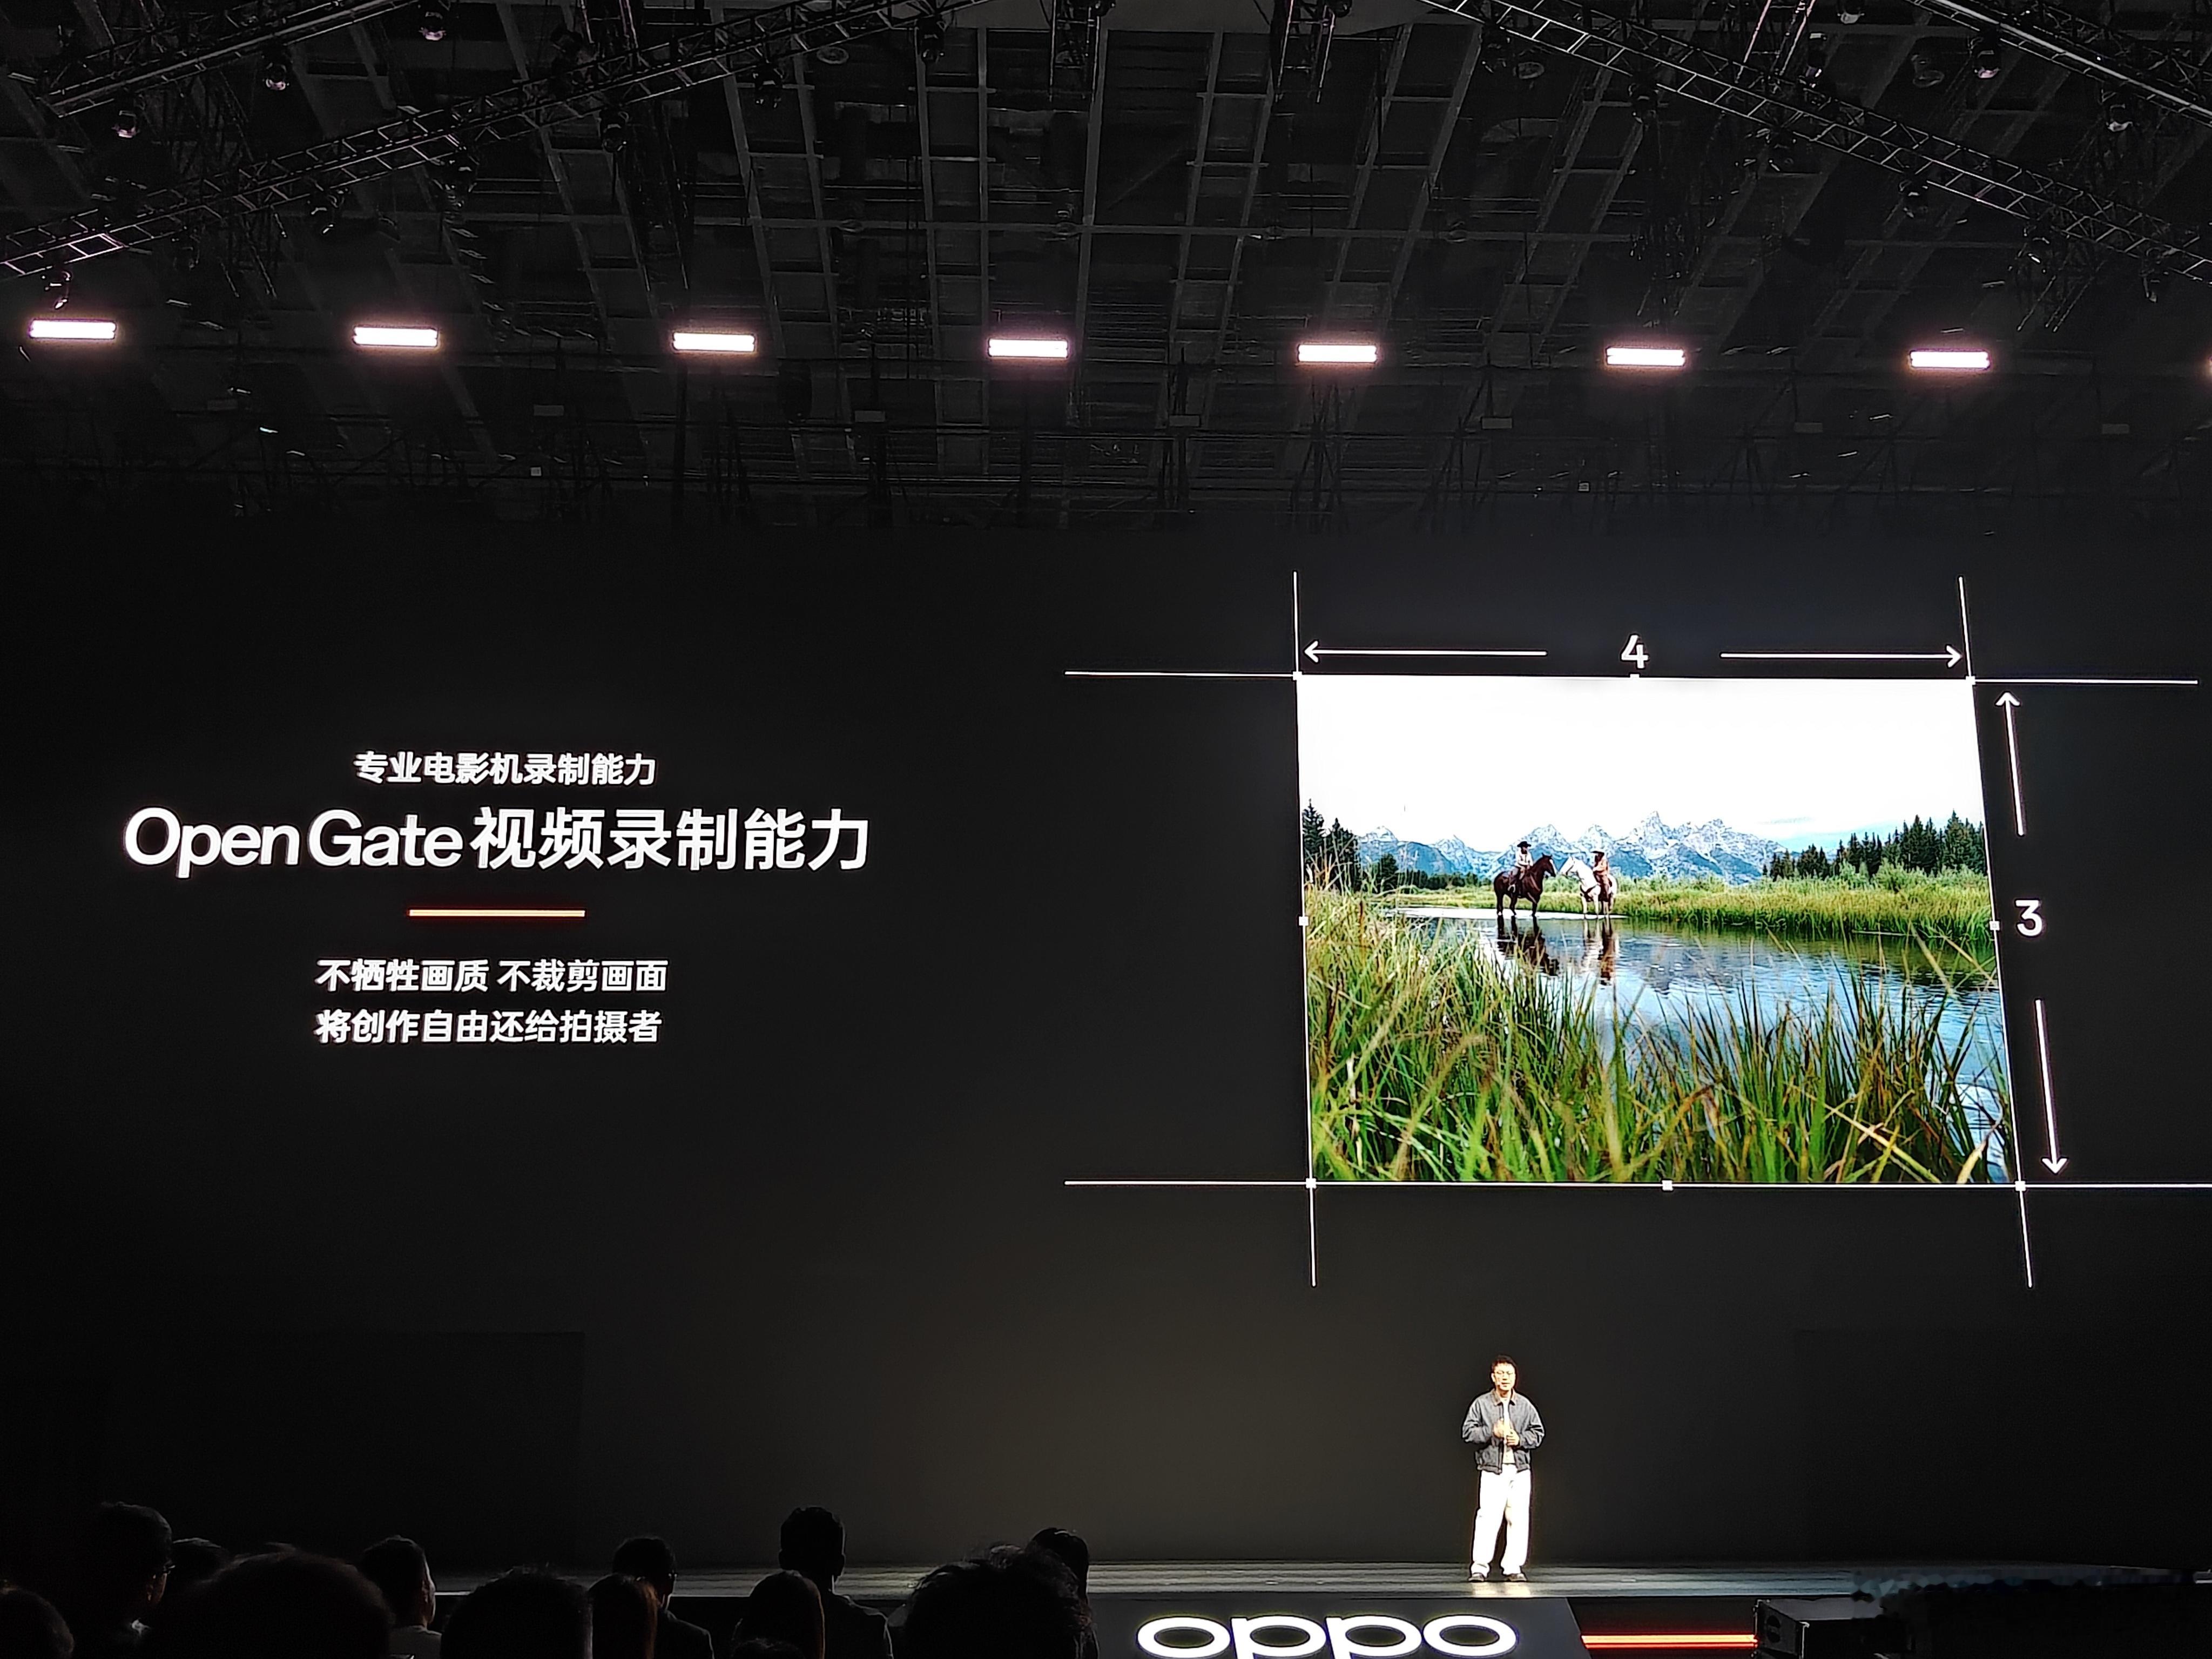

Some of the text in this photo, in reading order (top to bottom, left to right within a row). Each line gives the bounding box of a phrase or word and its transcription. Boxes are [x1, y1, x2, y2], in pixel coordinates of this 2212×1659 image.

[1621, 635, 1649, 669] 4
[353, 750, 656, 786] 专业电影机录制能力
[2015, 900, 2045, 936] 3
[314, 958, 669, 993] 不牺牲画质 不裁剪画面
[313, 1008, 662, 1043] 将创作自由还给拍摄者
